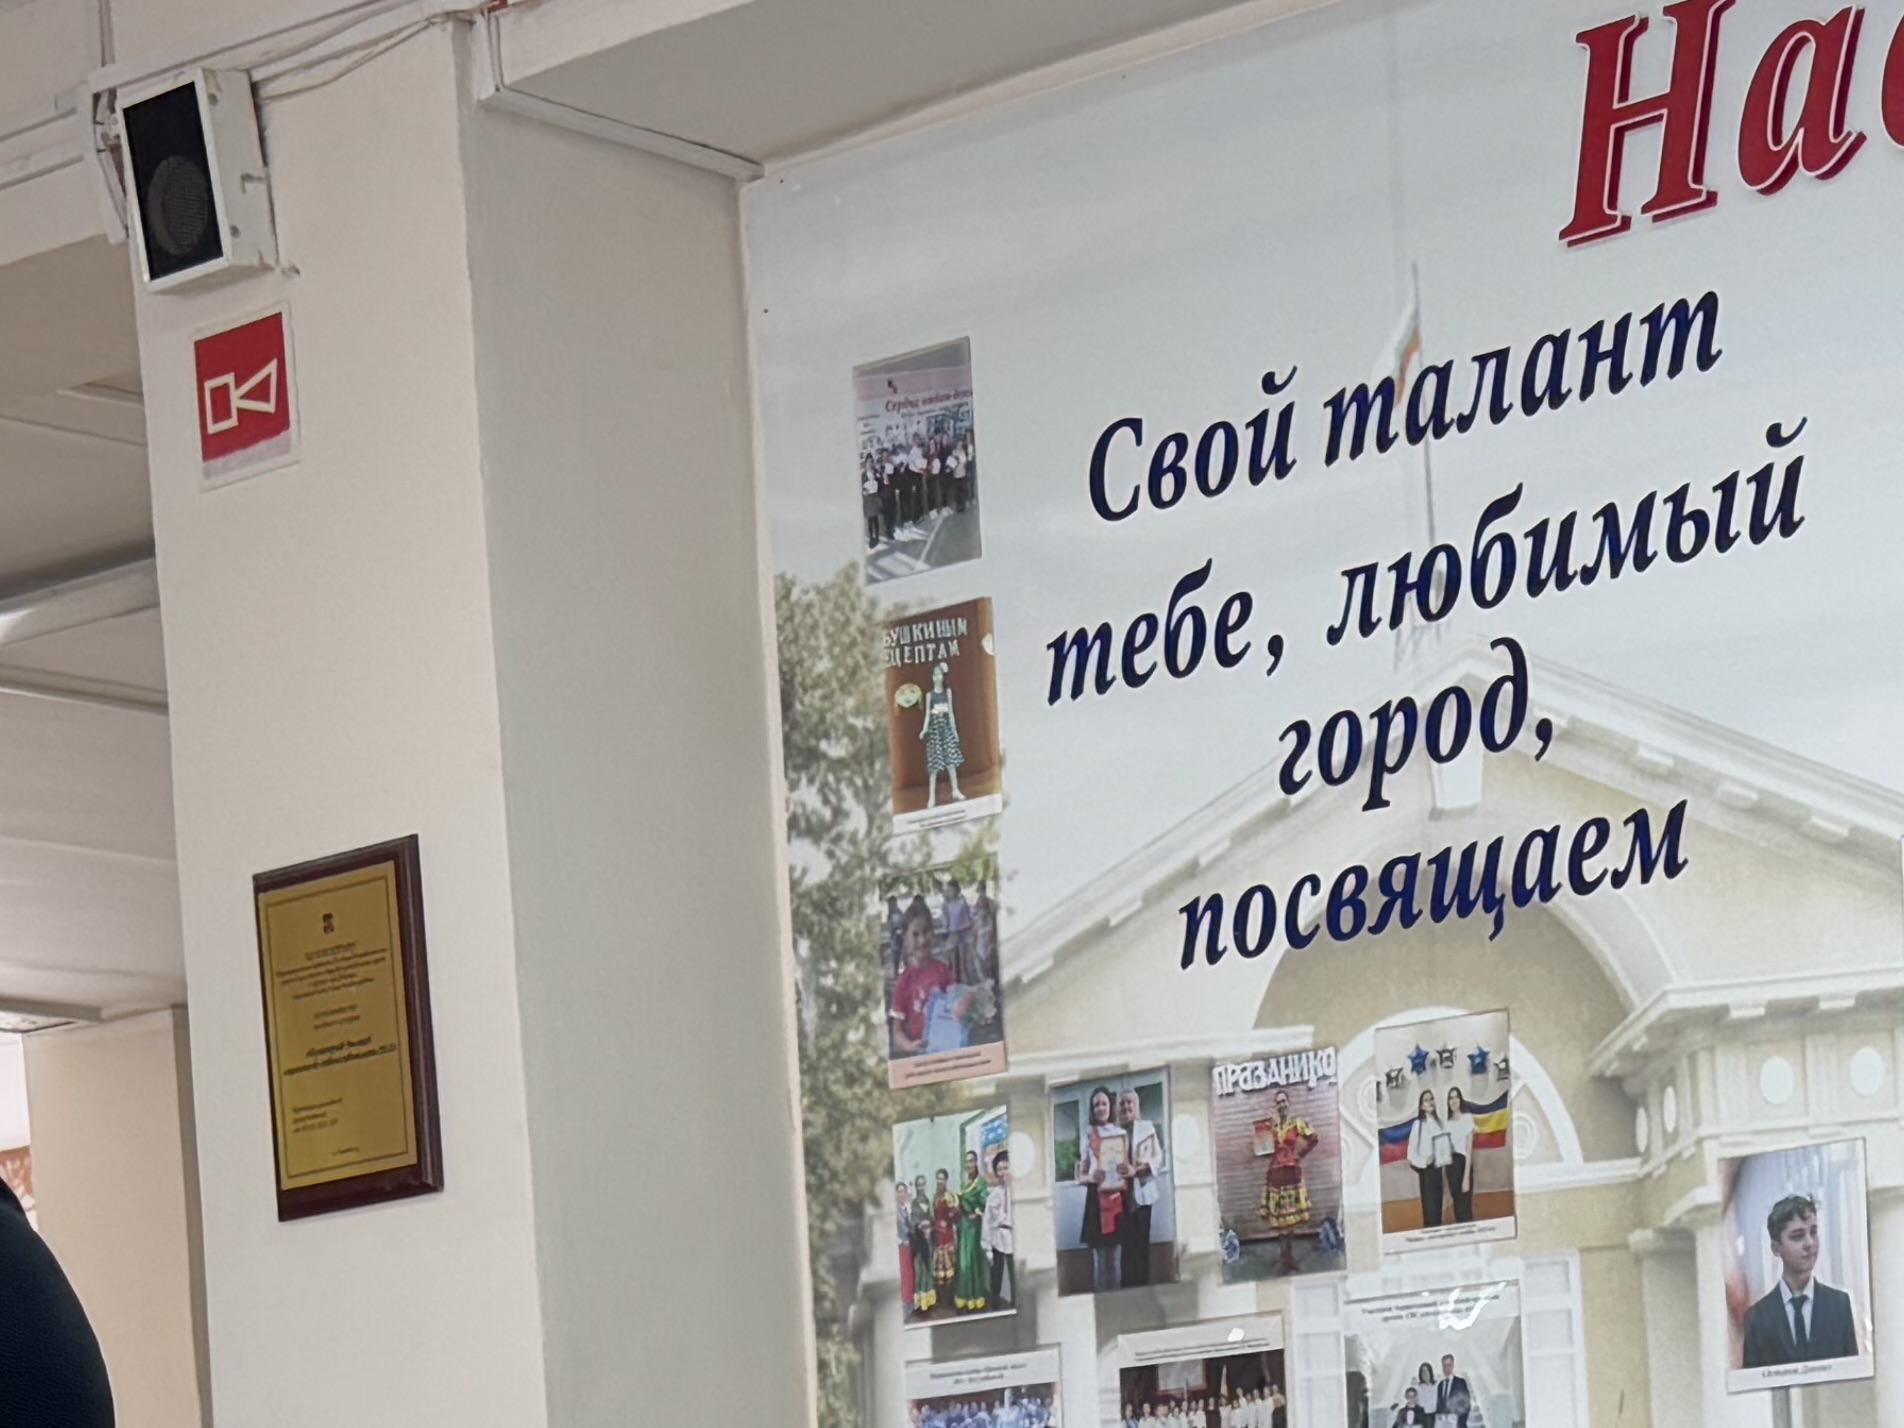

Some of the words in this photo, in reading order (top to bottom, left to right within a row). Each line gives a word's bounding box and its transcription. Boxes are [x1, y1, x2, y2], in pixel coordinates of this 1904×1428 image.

[1088, 365, 1298, 522] Свой
[1323, 291, 1723, 468] талант
[1045, 558, 1286, 703] тебе,
[1326, 417, 1809, 645] любимый
[1277, 636, 1554, 812] город,
[1178, 799, 1690, 970] посвящаем
